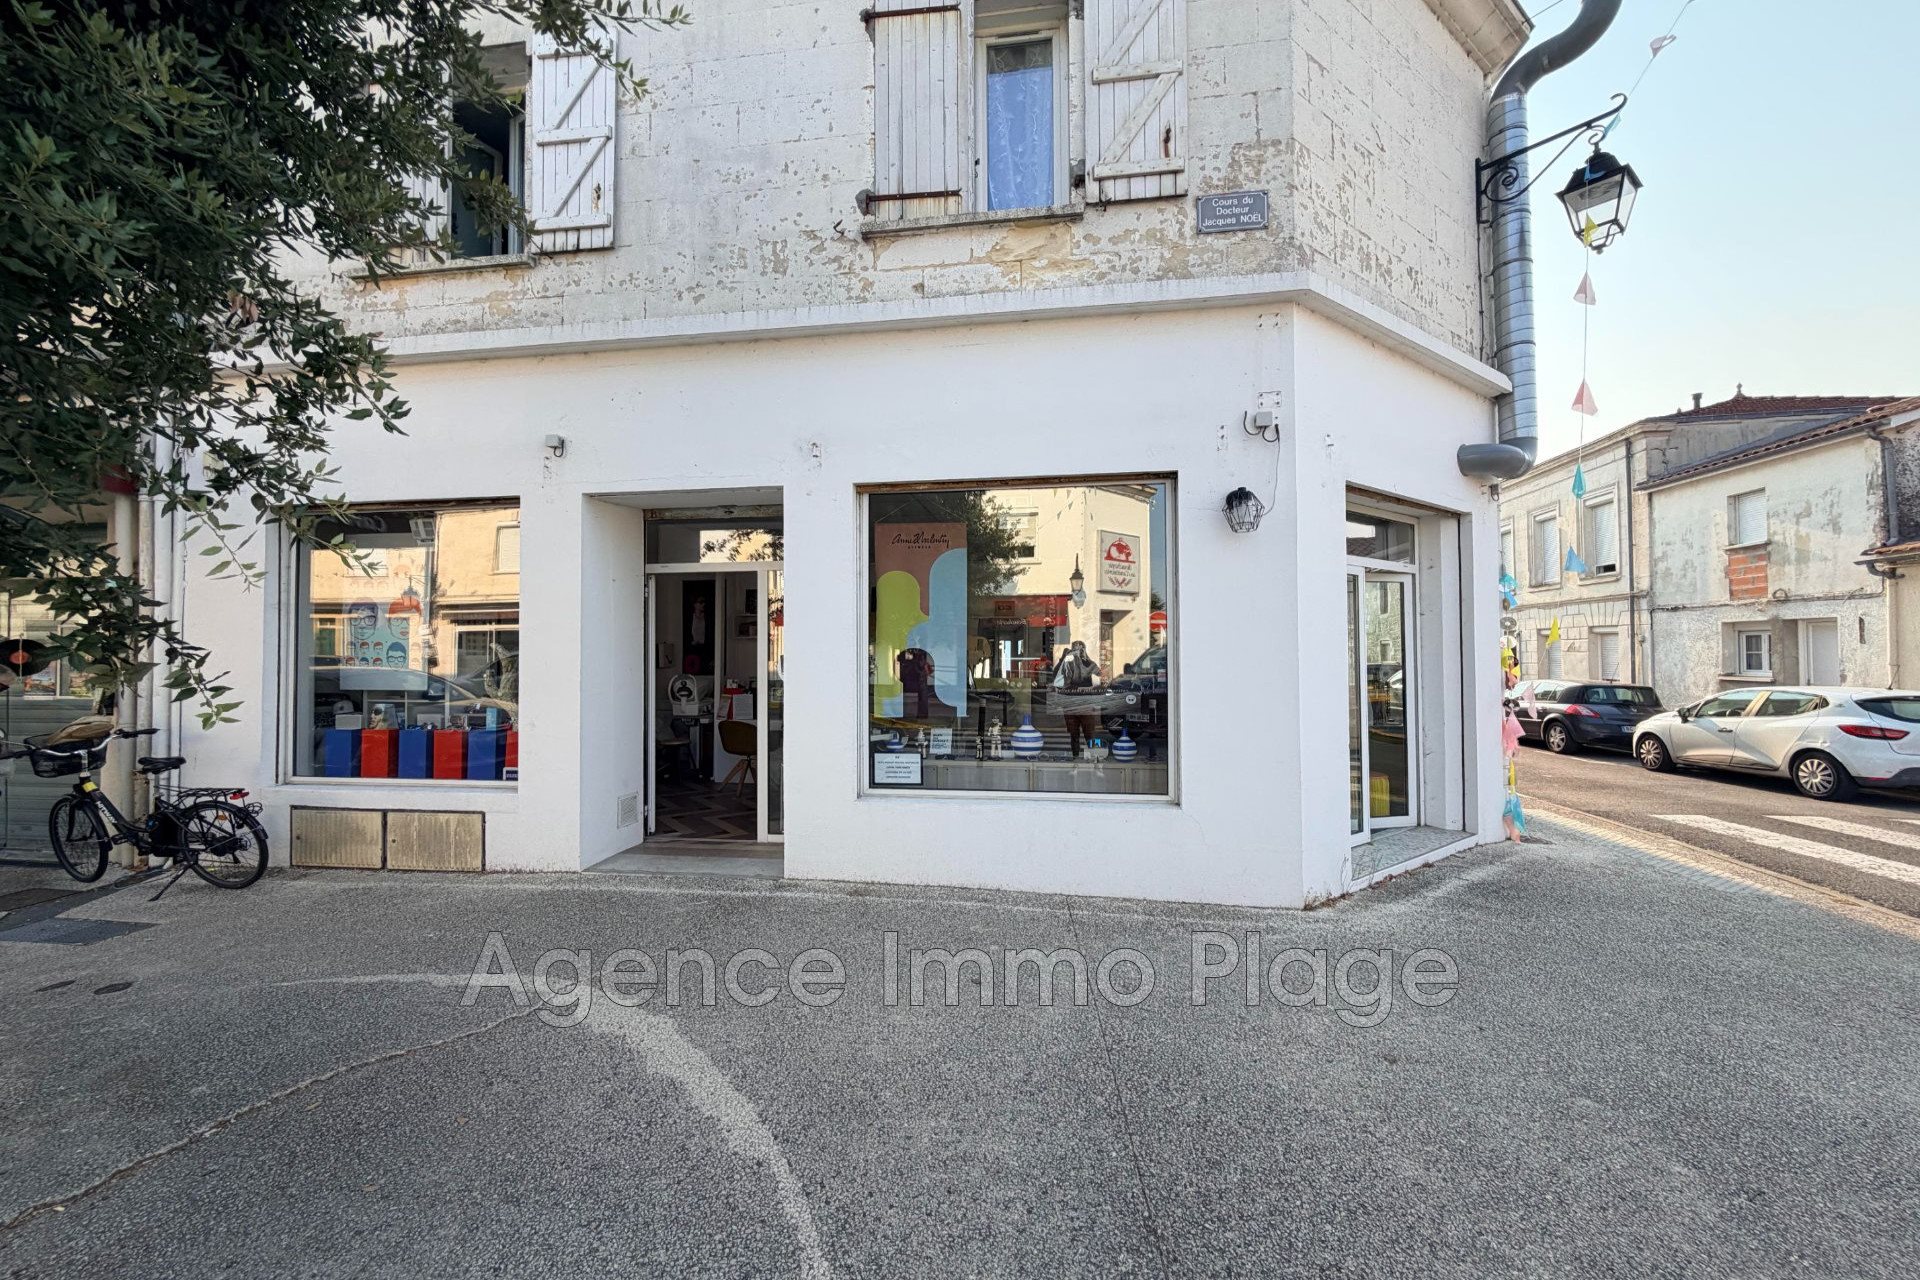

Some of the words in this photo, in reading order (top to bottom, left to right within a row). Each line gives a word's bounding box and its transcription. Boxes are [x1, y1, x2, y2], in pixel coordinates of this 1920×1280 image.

[1212, 198, 1238, 206] Cours
[1242, 195, 1254, 204] du
[1216, 206, 1250, 215] Docteur
[1202, 217, 1236, 226] Jacques
[1240, 211, 1263, 223] NOËL
